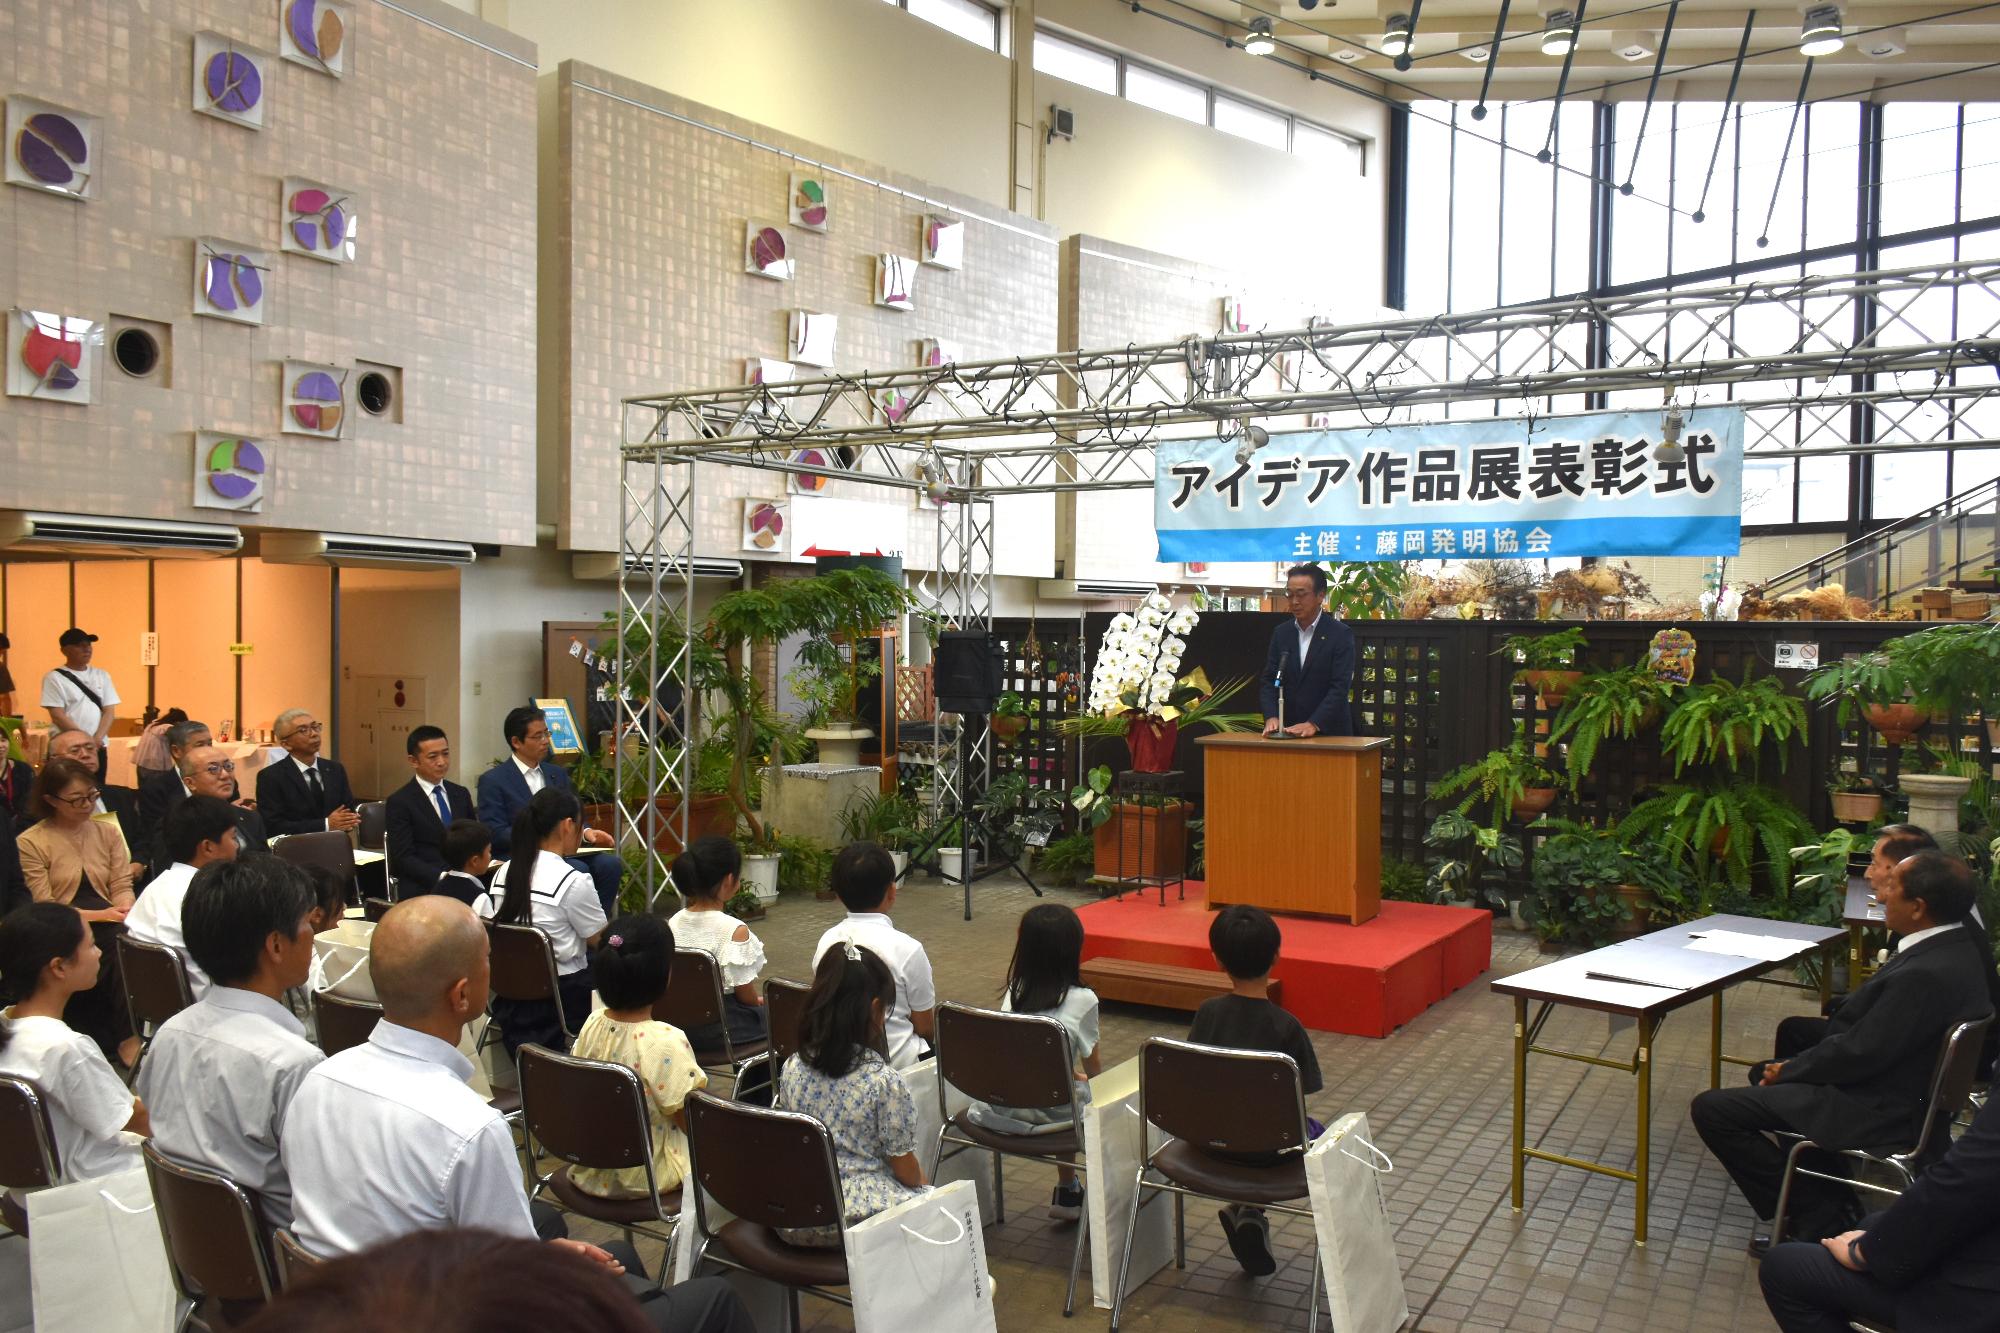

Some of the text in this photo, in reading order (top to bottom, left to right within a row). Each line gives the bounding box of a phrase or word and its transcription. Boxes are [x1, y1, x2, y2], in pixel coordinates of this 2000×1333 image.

[1171, 434, 1716, 508] アイデア作品展表彰式
